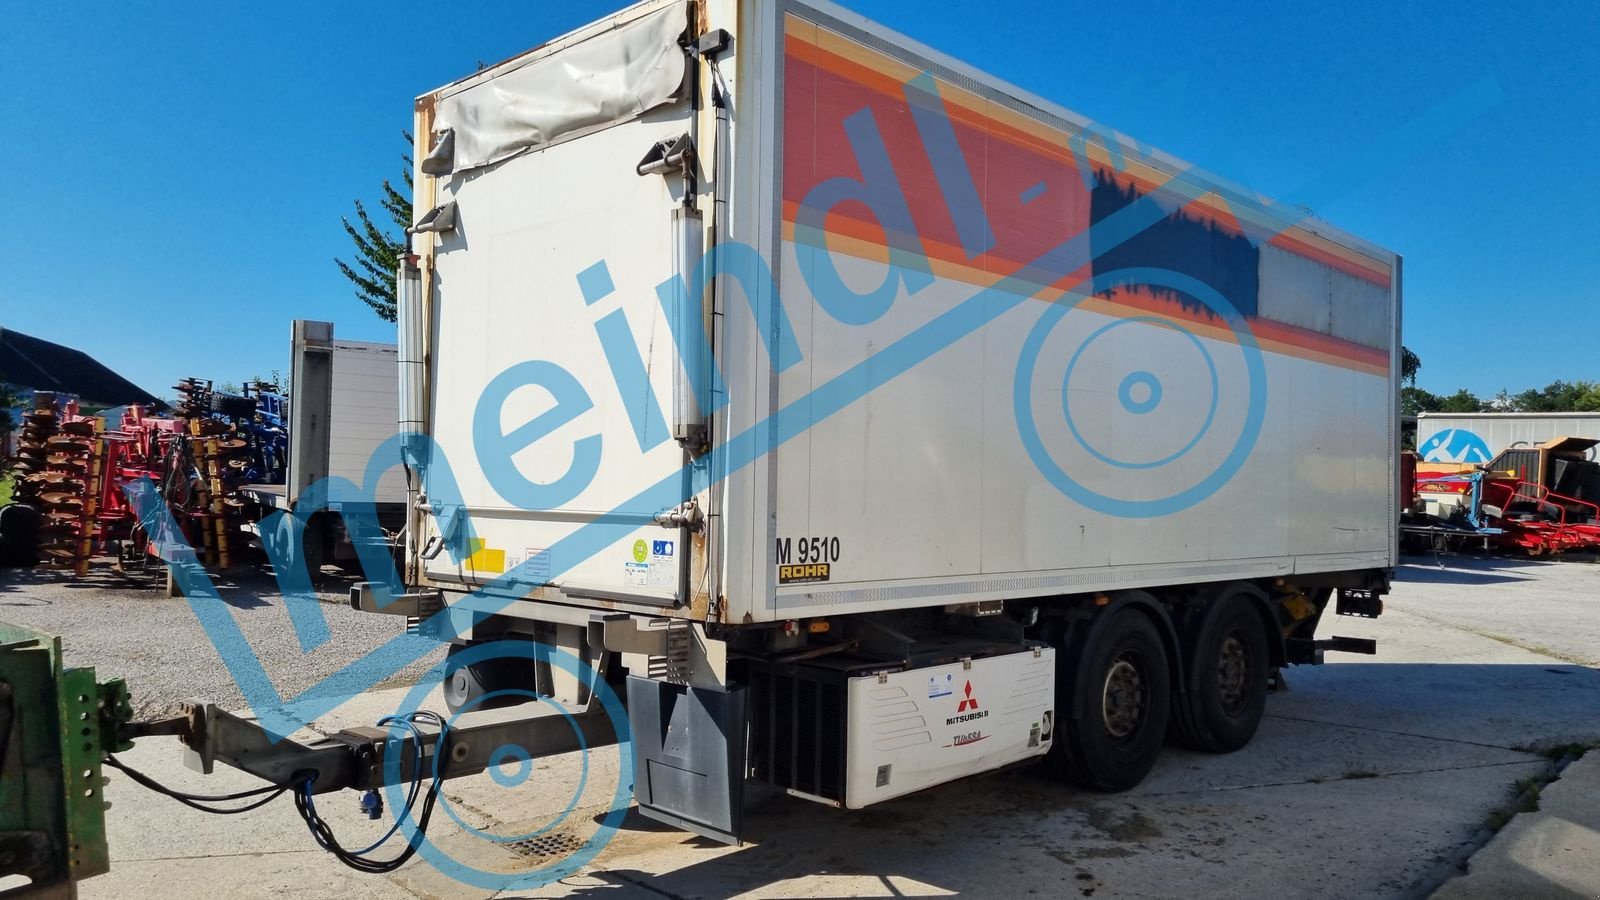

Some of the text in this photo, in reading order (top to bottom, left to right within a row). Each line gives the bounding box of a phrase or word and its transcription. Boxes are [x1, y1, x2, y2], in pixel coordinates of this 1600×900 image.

[776, 536, 840, 565] M 9510
[780, 565, 828, 578] ROHR
